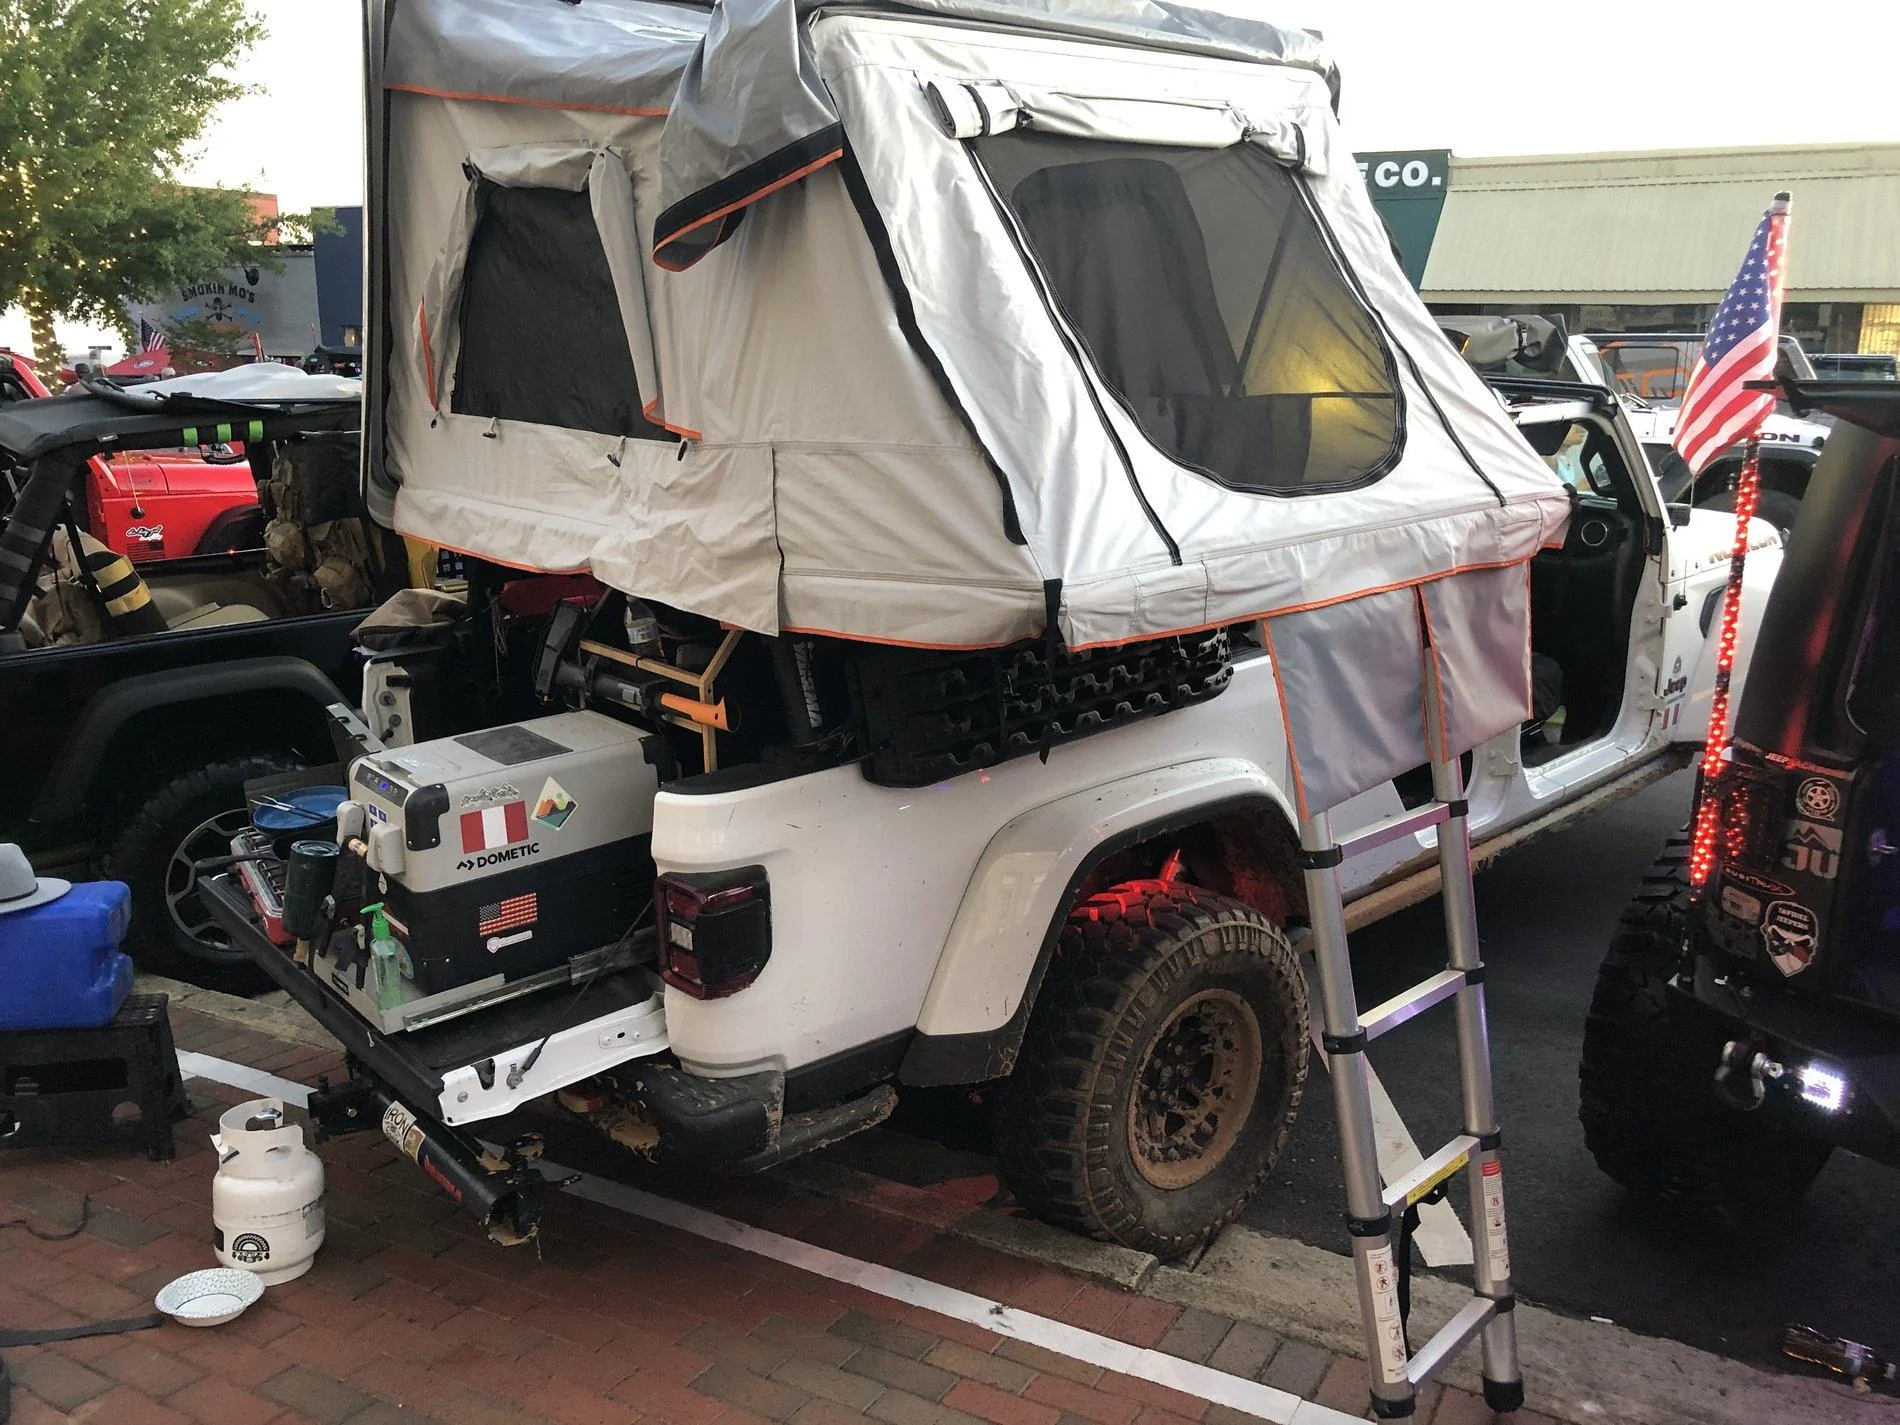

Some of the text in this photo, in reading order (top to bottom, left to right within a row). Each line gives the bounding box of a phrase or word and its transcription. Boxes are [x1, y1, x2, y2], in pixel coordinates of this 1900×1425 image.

[1375, 160, 1442, 188] CO.
[181, 282, 225, 302] SMOKIN
[476, 843, 540, 869] DOMETIC
[384, 1106, 410, 1137] IRON
